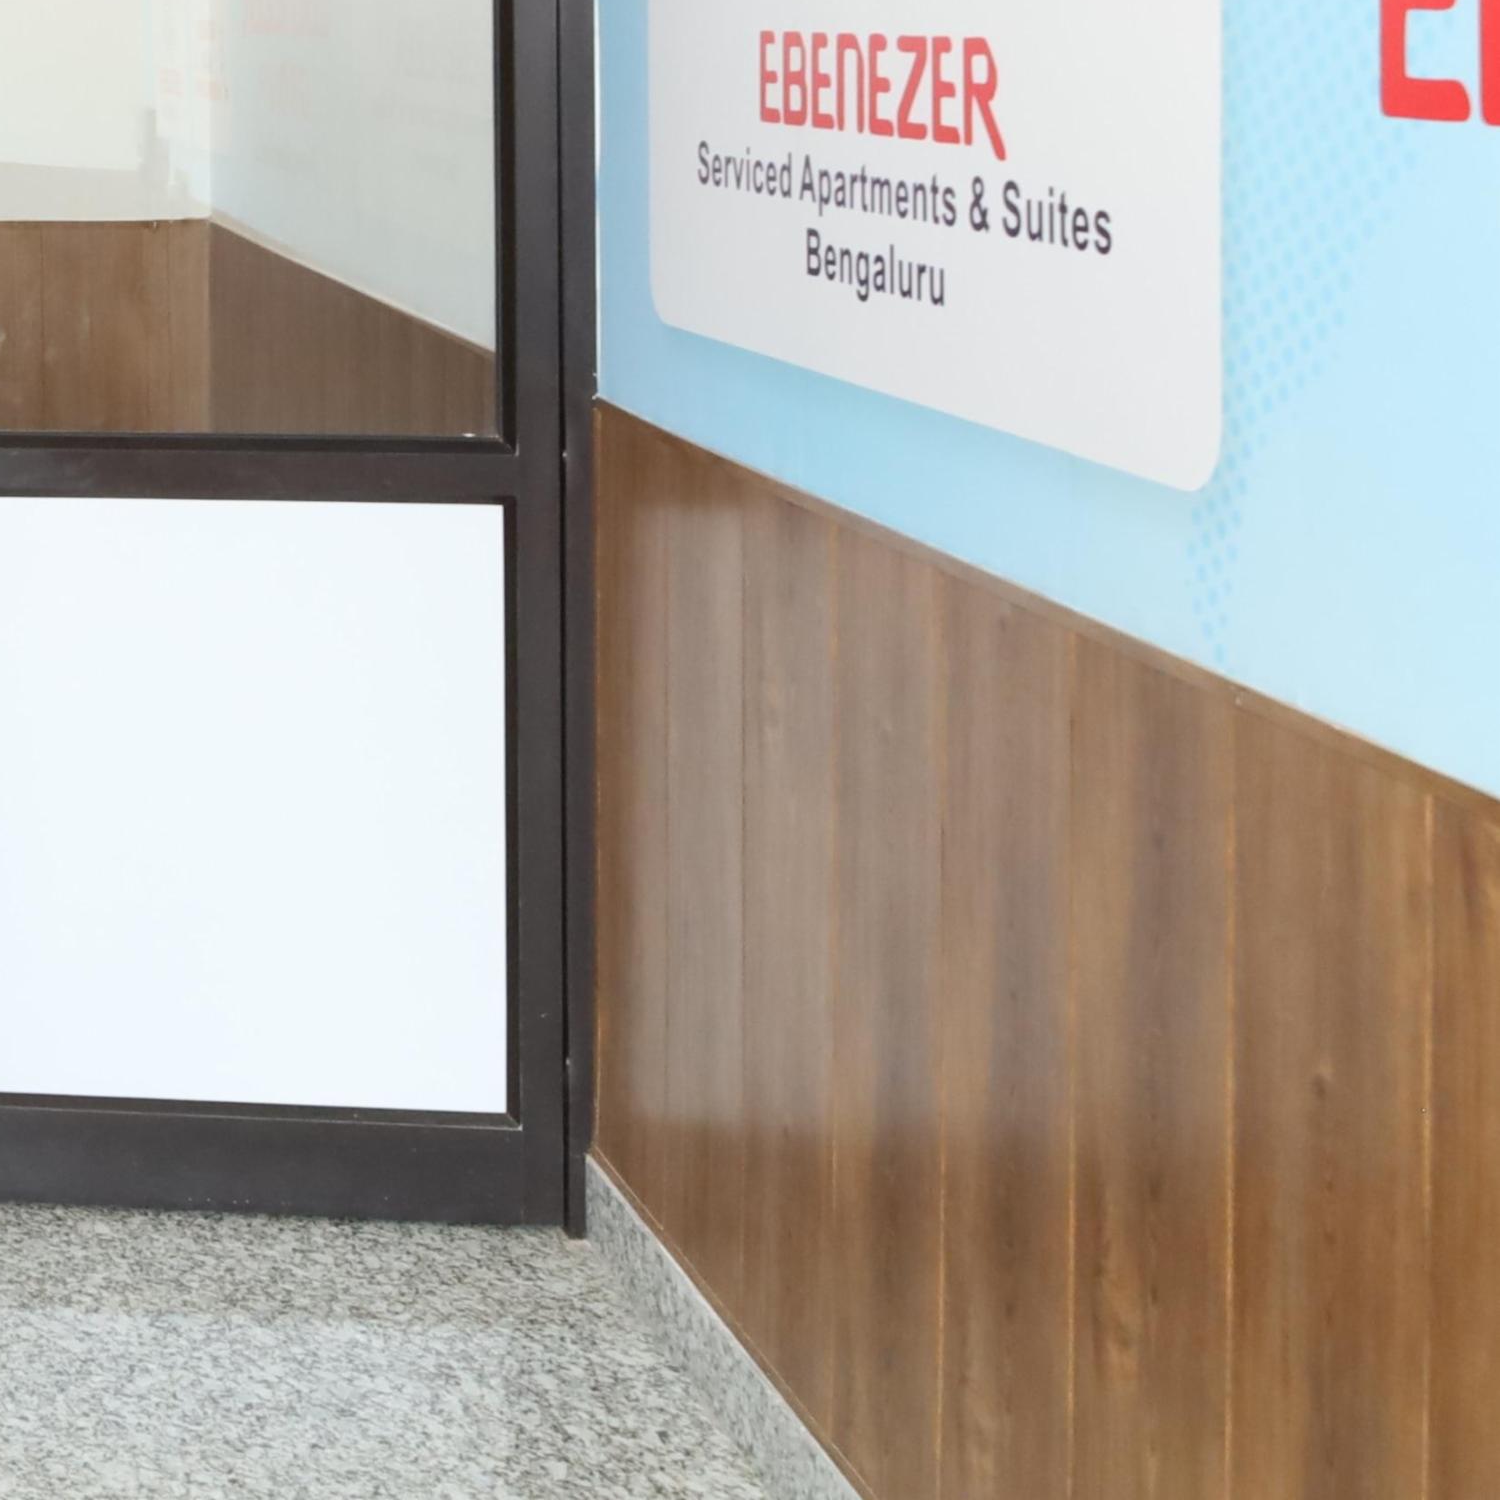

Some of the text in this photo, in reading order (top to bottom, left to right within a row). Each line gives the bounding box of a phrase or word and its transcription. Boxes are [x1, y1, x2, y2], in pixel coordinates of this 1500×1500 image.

[759, 30, 1007, 161] EBENEZER
[697, 140, 1112, 255] Serviced Apartments & Suites
[805, 227, 946, 308] Bengaluru
